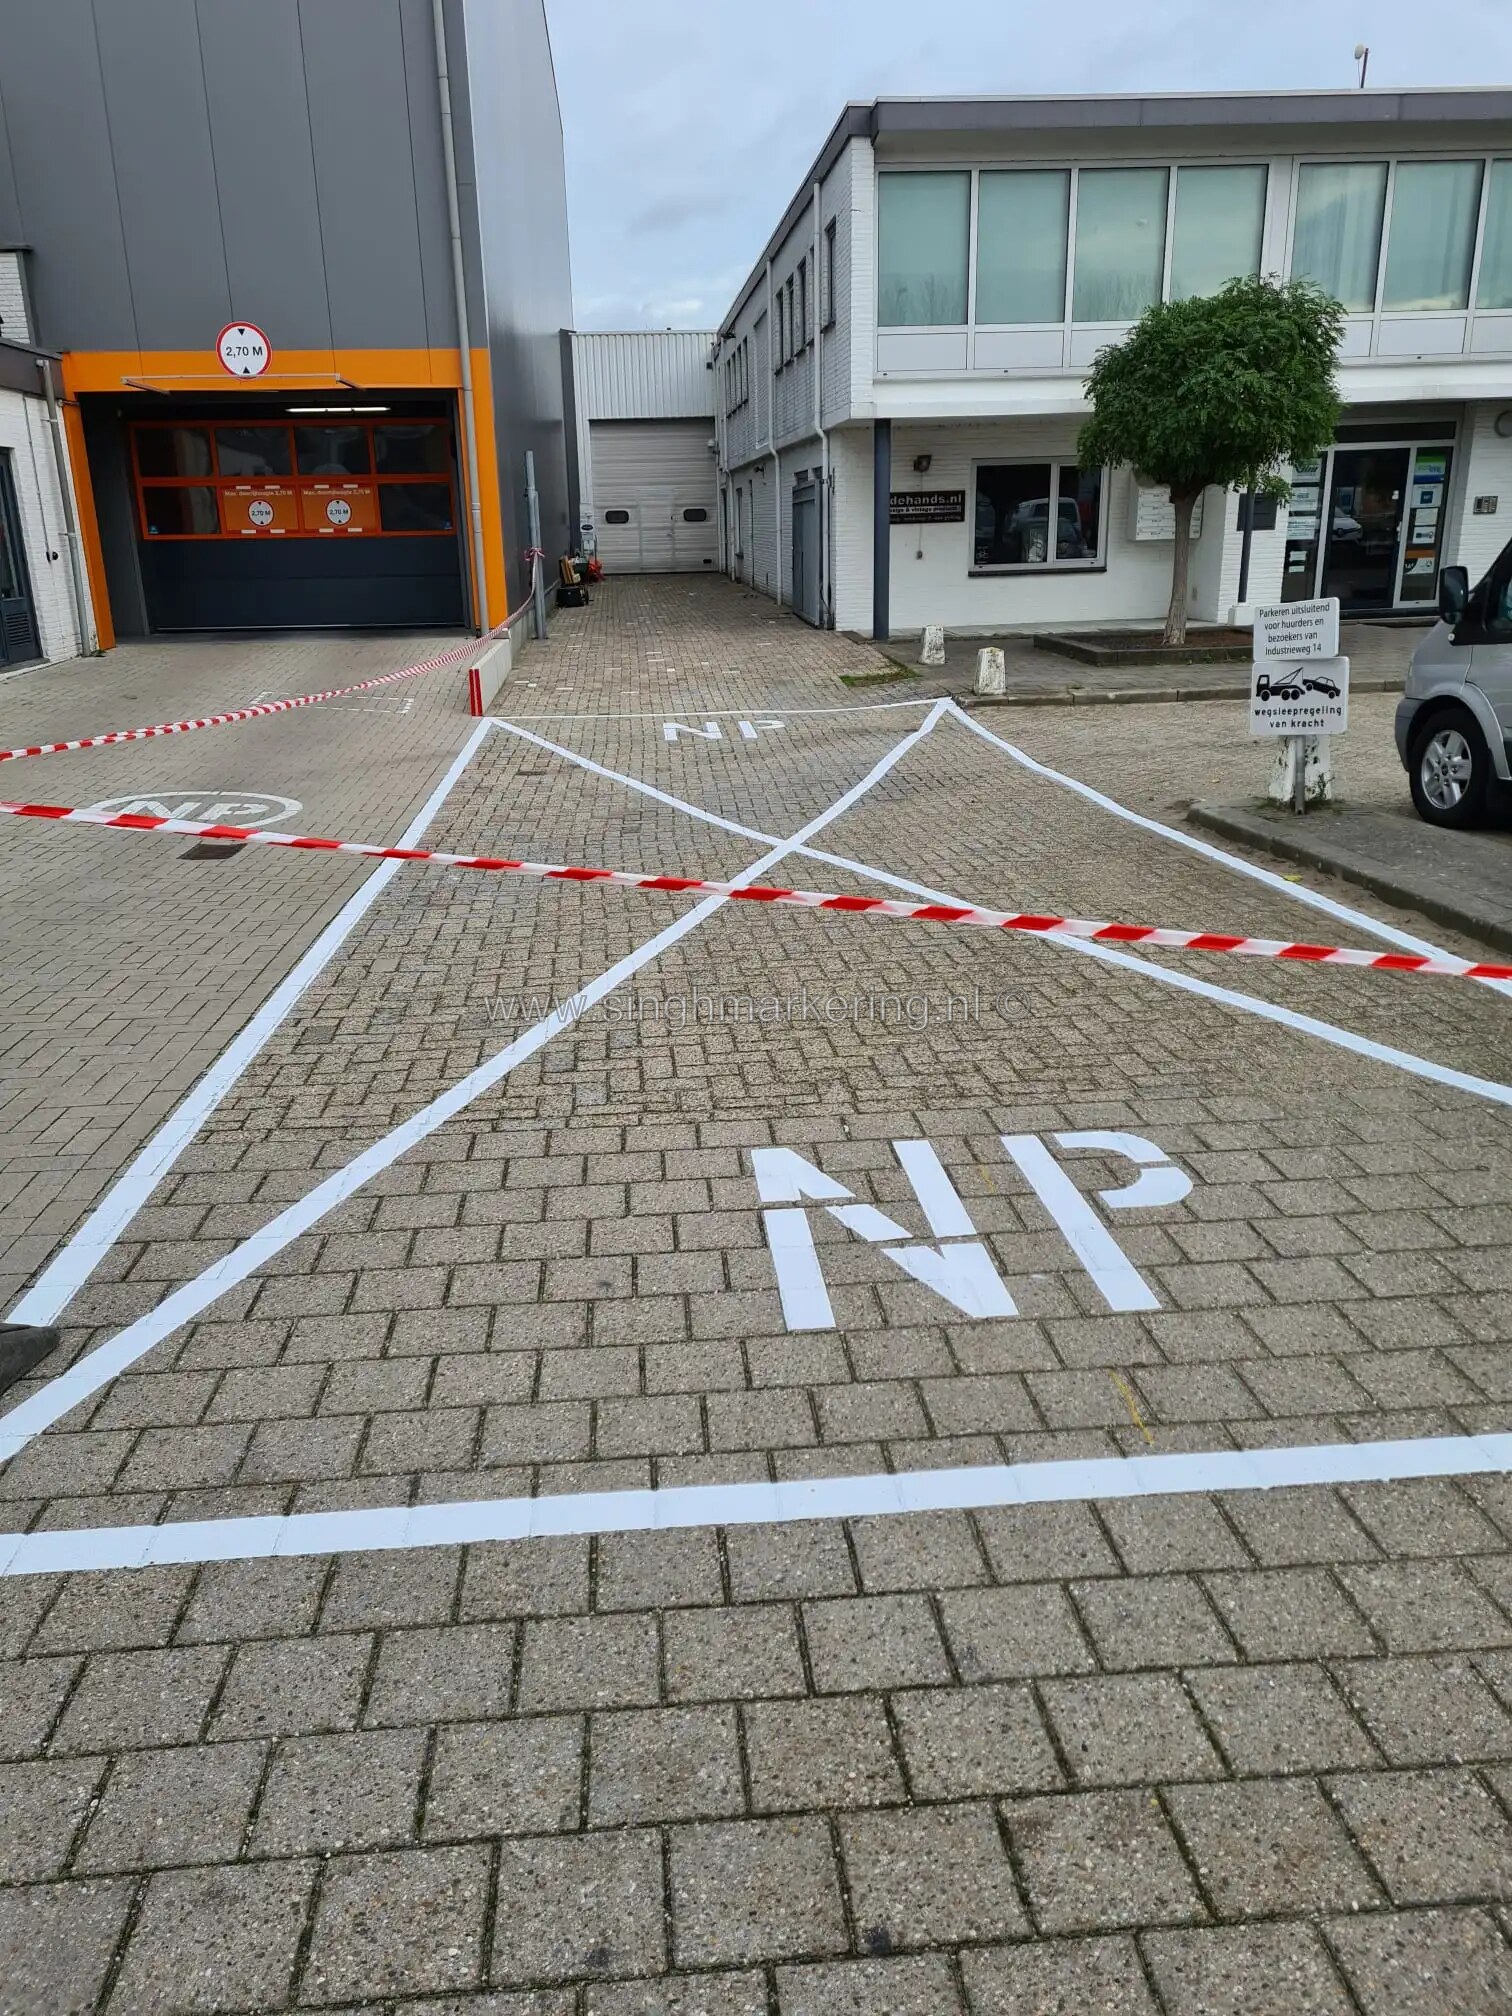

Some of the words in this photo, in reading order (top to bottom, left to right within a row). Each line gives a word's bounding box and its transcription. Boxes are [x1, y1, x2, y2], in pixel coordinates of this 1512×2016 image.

[225, 345, 249, 359] 2,70
[252, 345, 263, 356] M
[1259, 607, 1290, 618] Parkeren
[1291, 602, 1330, 615] uitsluitend
[1264, 621, 1280, 630] voor
[1281, 618, 1313, 629] huurders
[1314, 618, 1324, 626] en
[1268, 631, 1303, 643] bezoekers
[1304, 631, 1318, 640] van
[1265, 645, 1311, 656] Industrieweg
[1313, 643, 1322, 652] 14
[1254, 706, 1342, 717] wegsleepregeling
[1291, 719, 1325, 728] kracht
[663, 720, 786, 741] NP
[116, 800, 270, 821] NP
[751, 1131, 1194, 1331] NP
